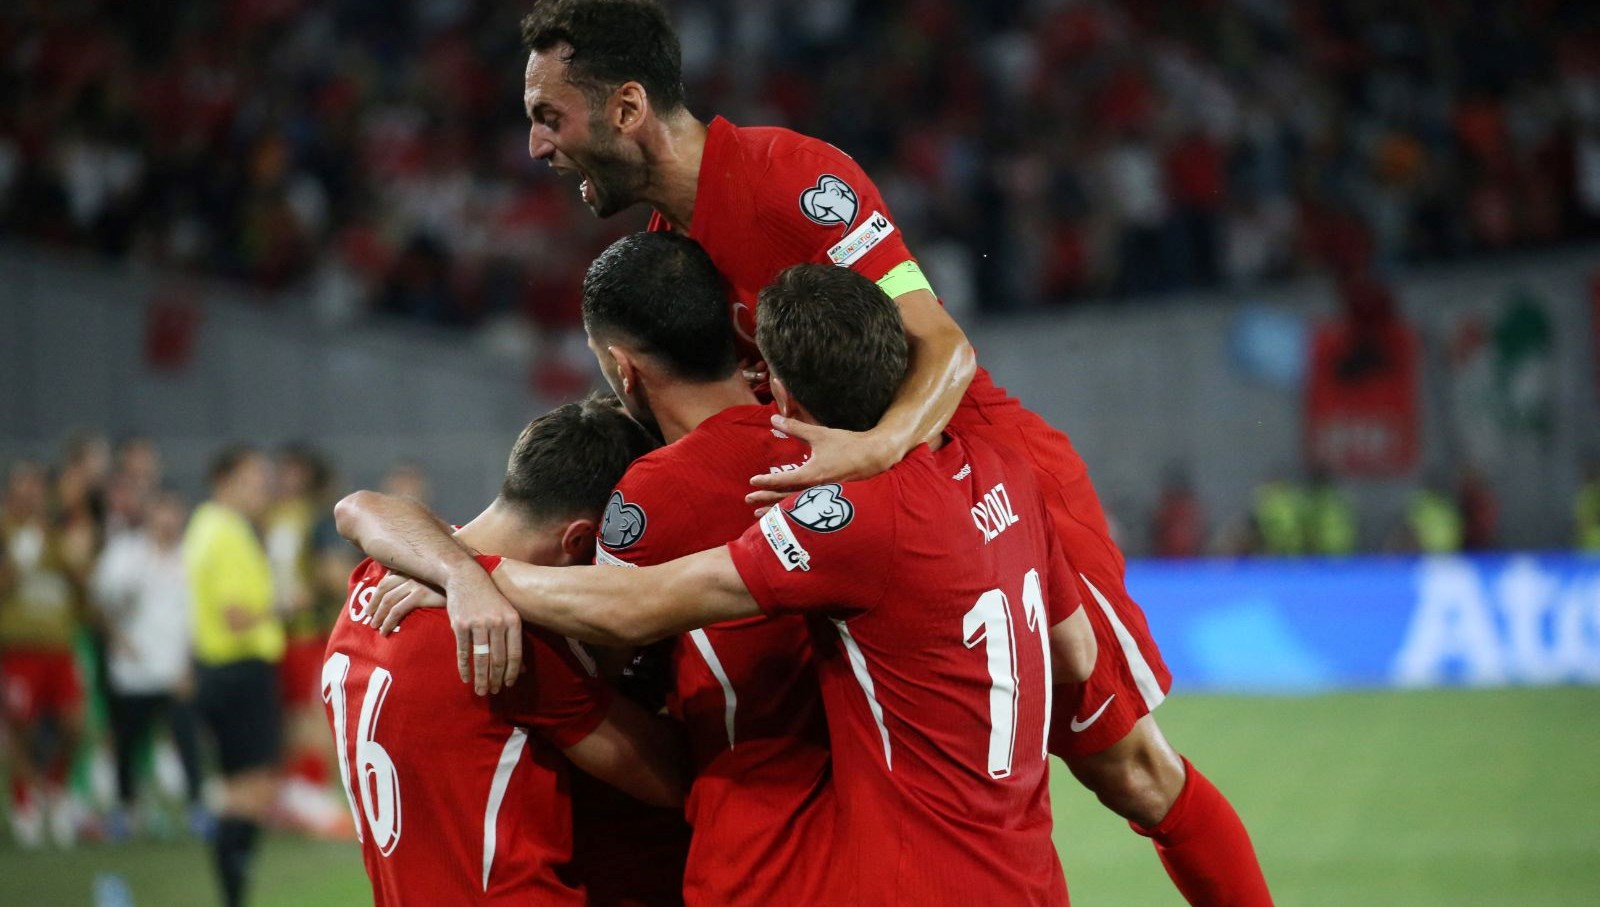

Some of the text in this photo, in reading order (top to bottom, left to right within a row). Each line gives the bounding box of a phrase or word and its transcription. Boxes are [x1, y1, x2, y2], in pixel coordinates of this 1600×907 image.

[833, 228, 876, 263] FOUNDATION
[321, 651, 402, 858] 16
[962, 567, 1054, 780] 11
